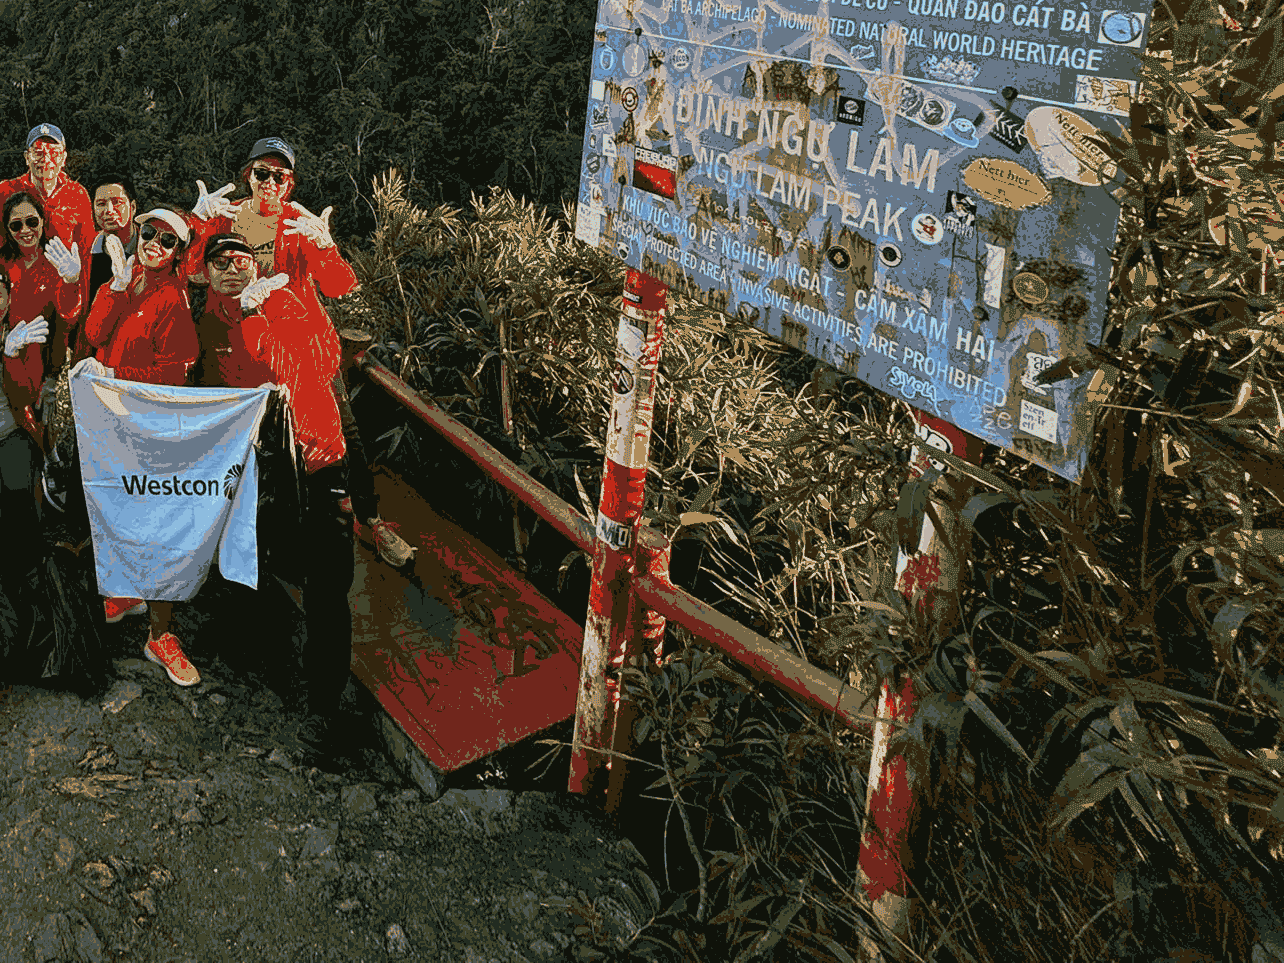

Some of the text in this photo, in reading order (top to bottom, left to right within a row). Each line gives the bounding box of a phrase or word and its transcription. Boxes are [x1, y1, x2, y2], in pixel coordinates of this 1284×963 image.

[694, 0, 767, 24] ARCHIPELAGO
[933, 30, 995, 56] WORLD
[1000, 38, 1103, 71] HERITAGE
[1012, 0, 1055, 29] CÁT
[1060, 2, 1090, 33] BÀ
[756, 164, 811, 212] LAM
[822, 185, 906, 241] PEAK
[978, 160, 1004, 177] Nett
[645, 235, 697, 269] PROTECTED
[699, 259, 727, 284] AREA
[738, 276, 791, 314] INVASIVE
[793, 302, 863, 346] ACTIVITIES
[867, 333, 899, 360] ARE
[903, 347, 1007, 407] PROHIBITED
[722, 236, 780, 276] NGHIÊM
[903, 306, 948, 344] XÂM
[956, 327, 995, 364] HẠI
[121, 475, 219, 496] Westcon
